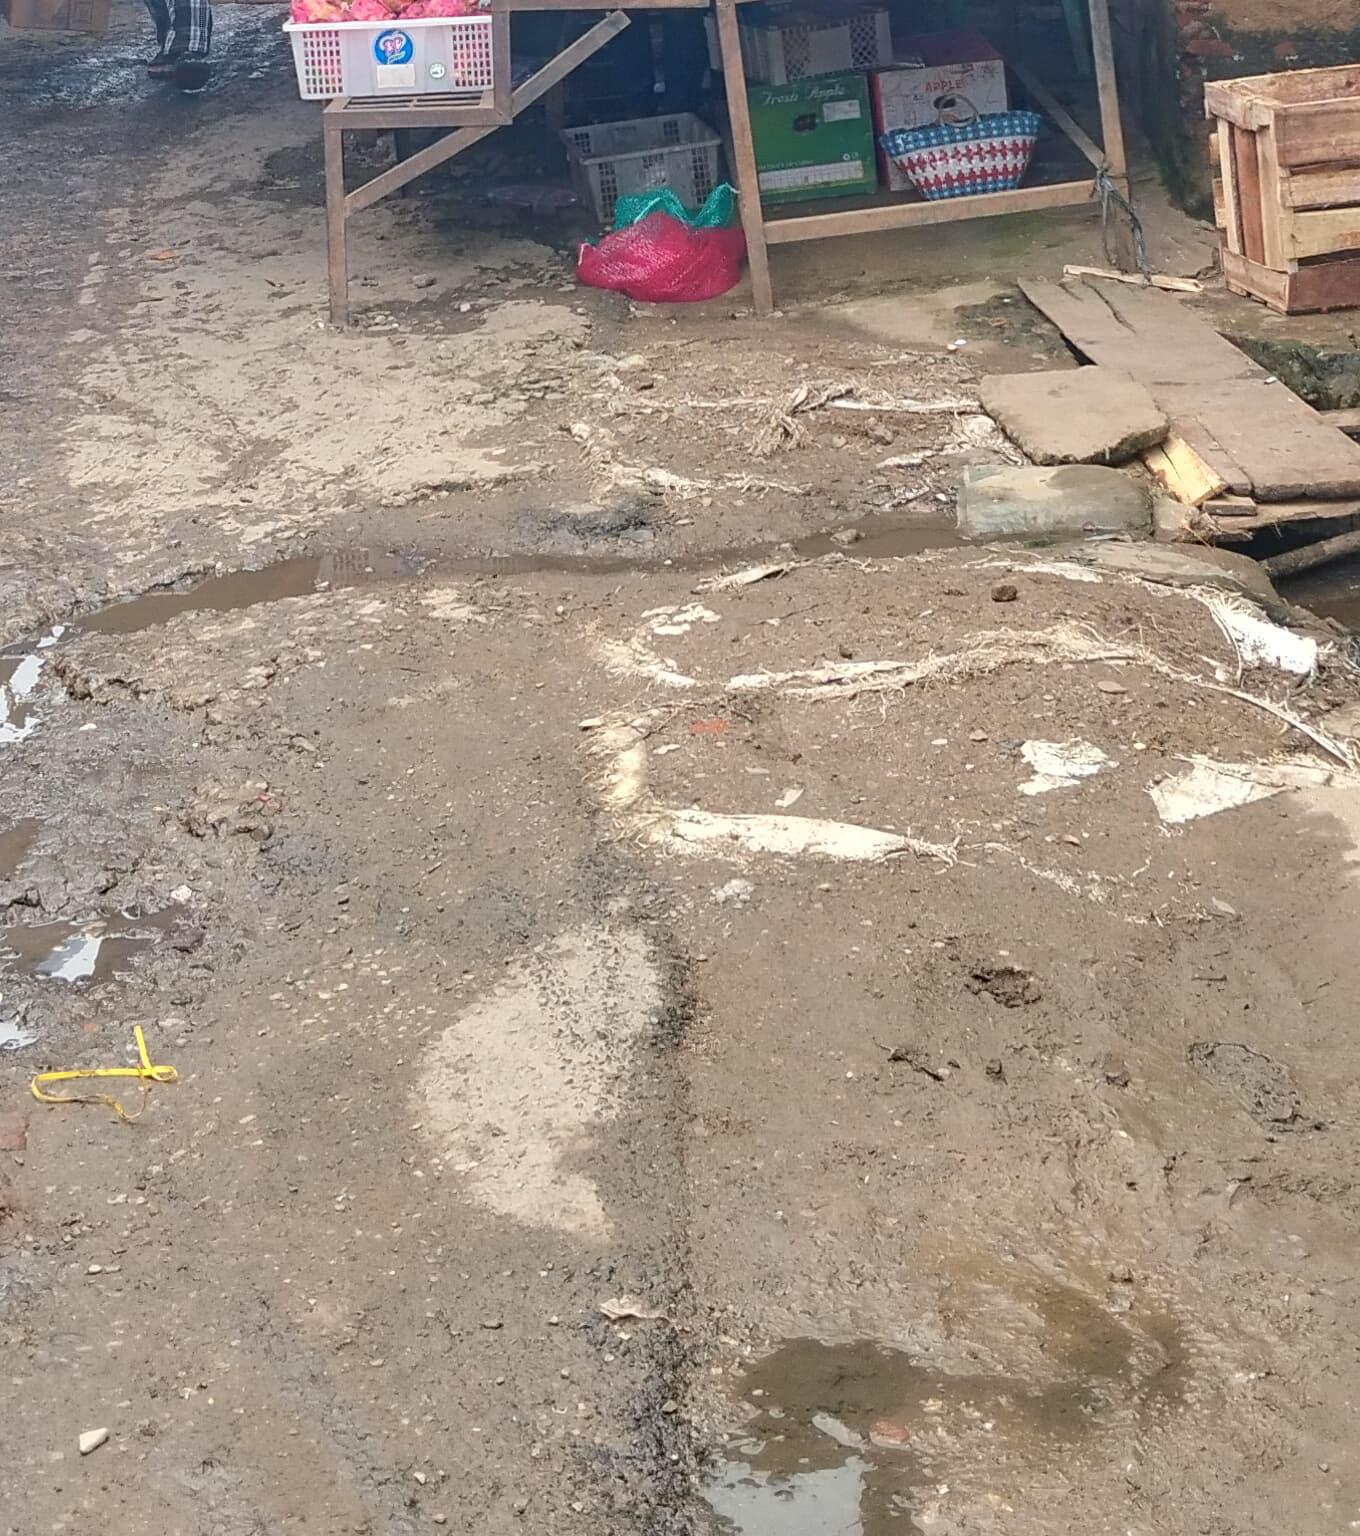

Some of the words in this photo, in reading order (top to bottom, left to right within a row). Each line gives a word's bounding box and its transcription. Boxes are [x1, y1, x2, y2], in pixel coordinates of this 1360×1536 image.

[925, 78, 963, 93] APPLE
[760, 91, 799, 106] Fresh
[807, 84, 848, 102] Apple
